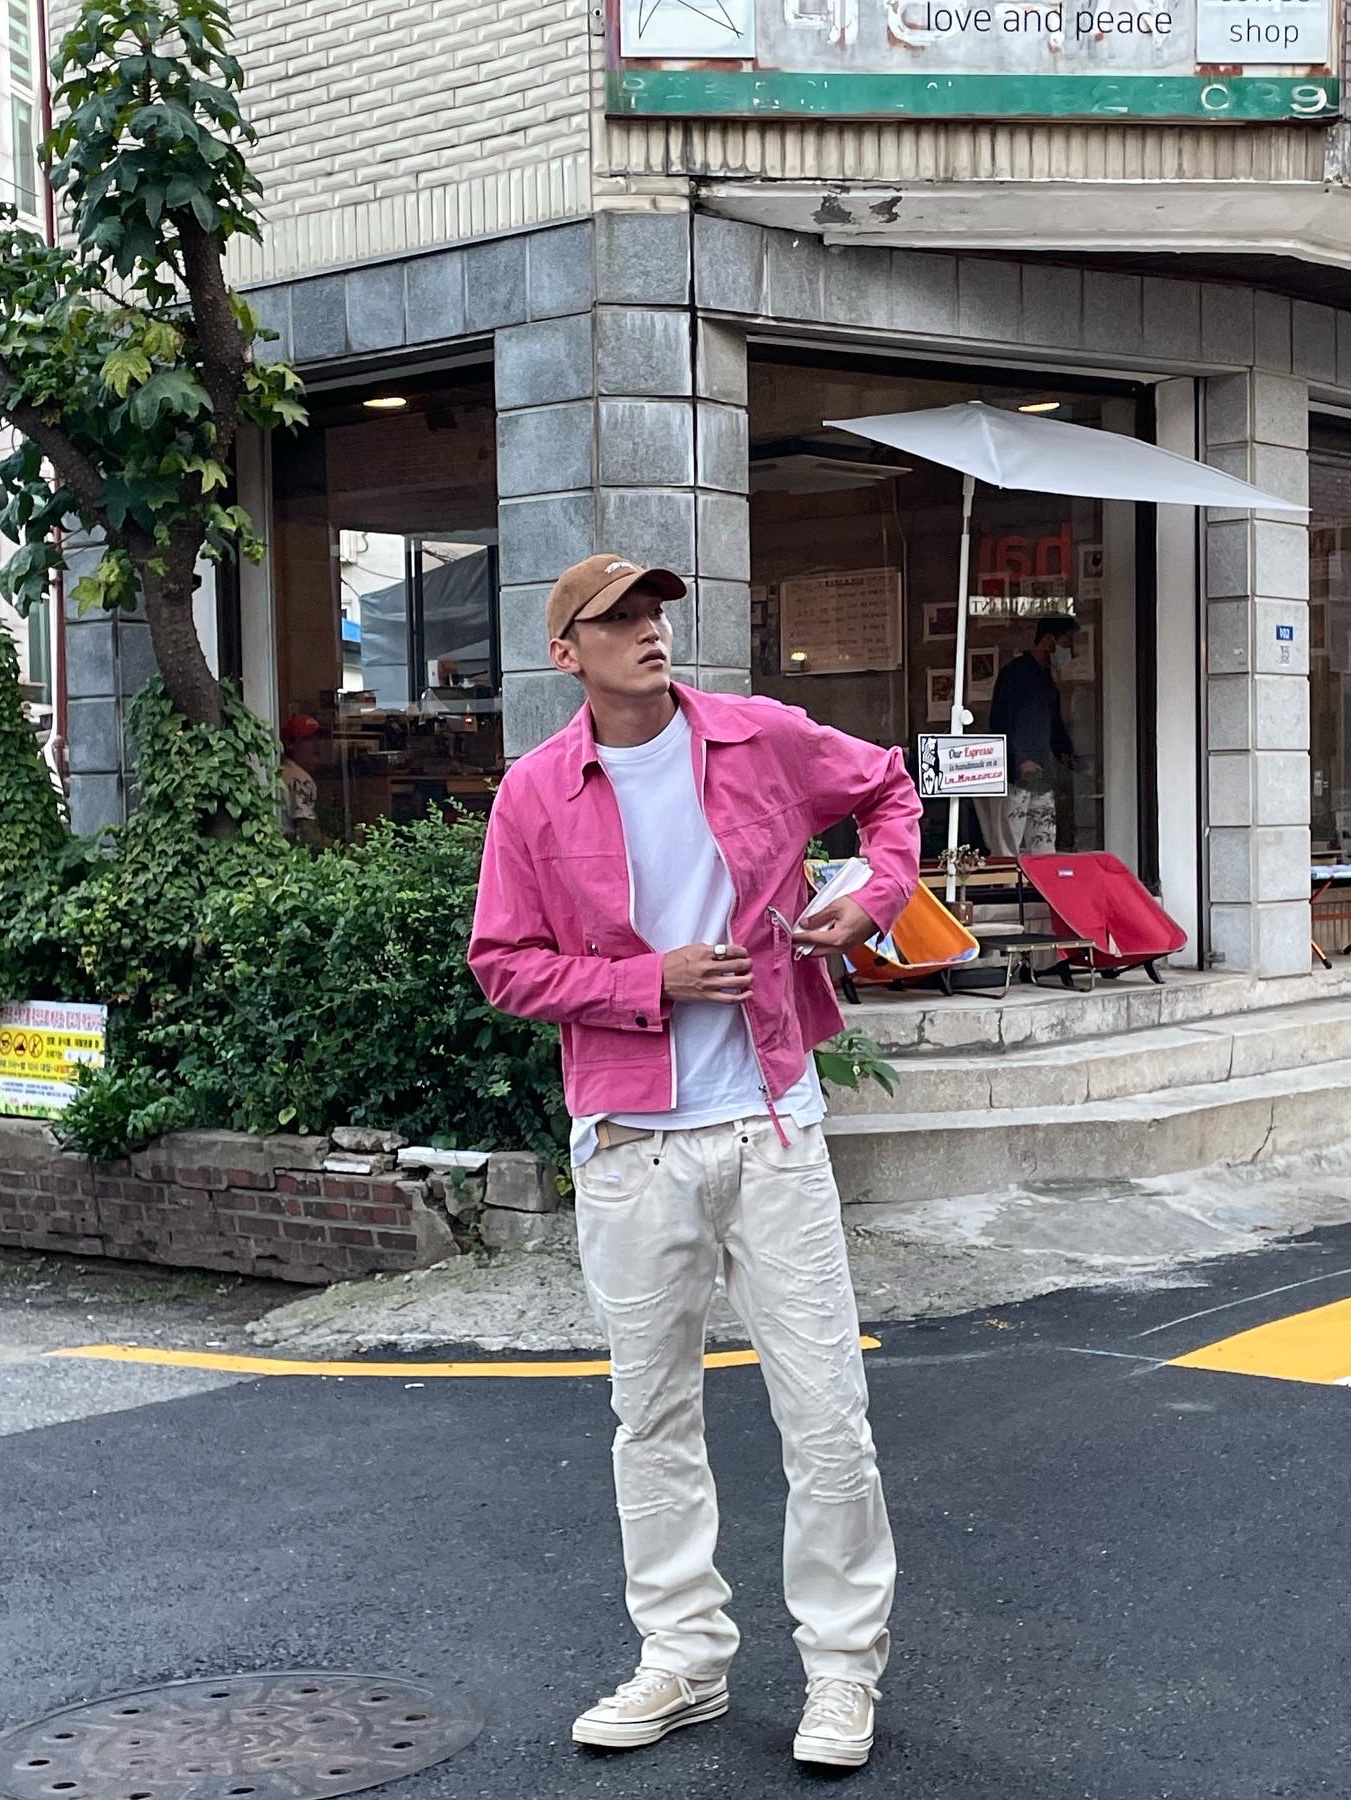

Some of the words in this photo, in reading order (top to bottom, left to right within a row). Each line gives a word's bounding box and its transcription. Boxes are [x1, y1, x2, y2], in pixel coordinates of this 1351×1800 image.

[926, 1, 991, 31] love
[1003, 3, 1062, 32] and
[1076, 11, 1172, 41] peace
[1230, 18, 1299, 49] shop
[949, 749, 962, 759] Our
